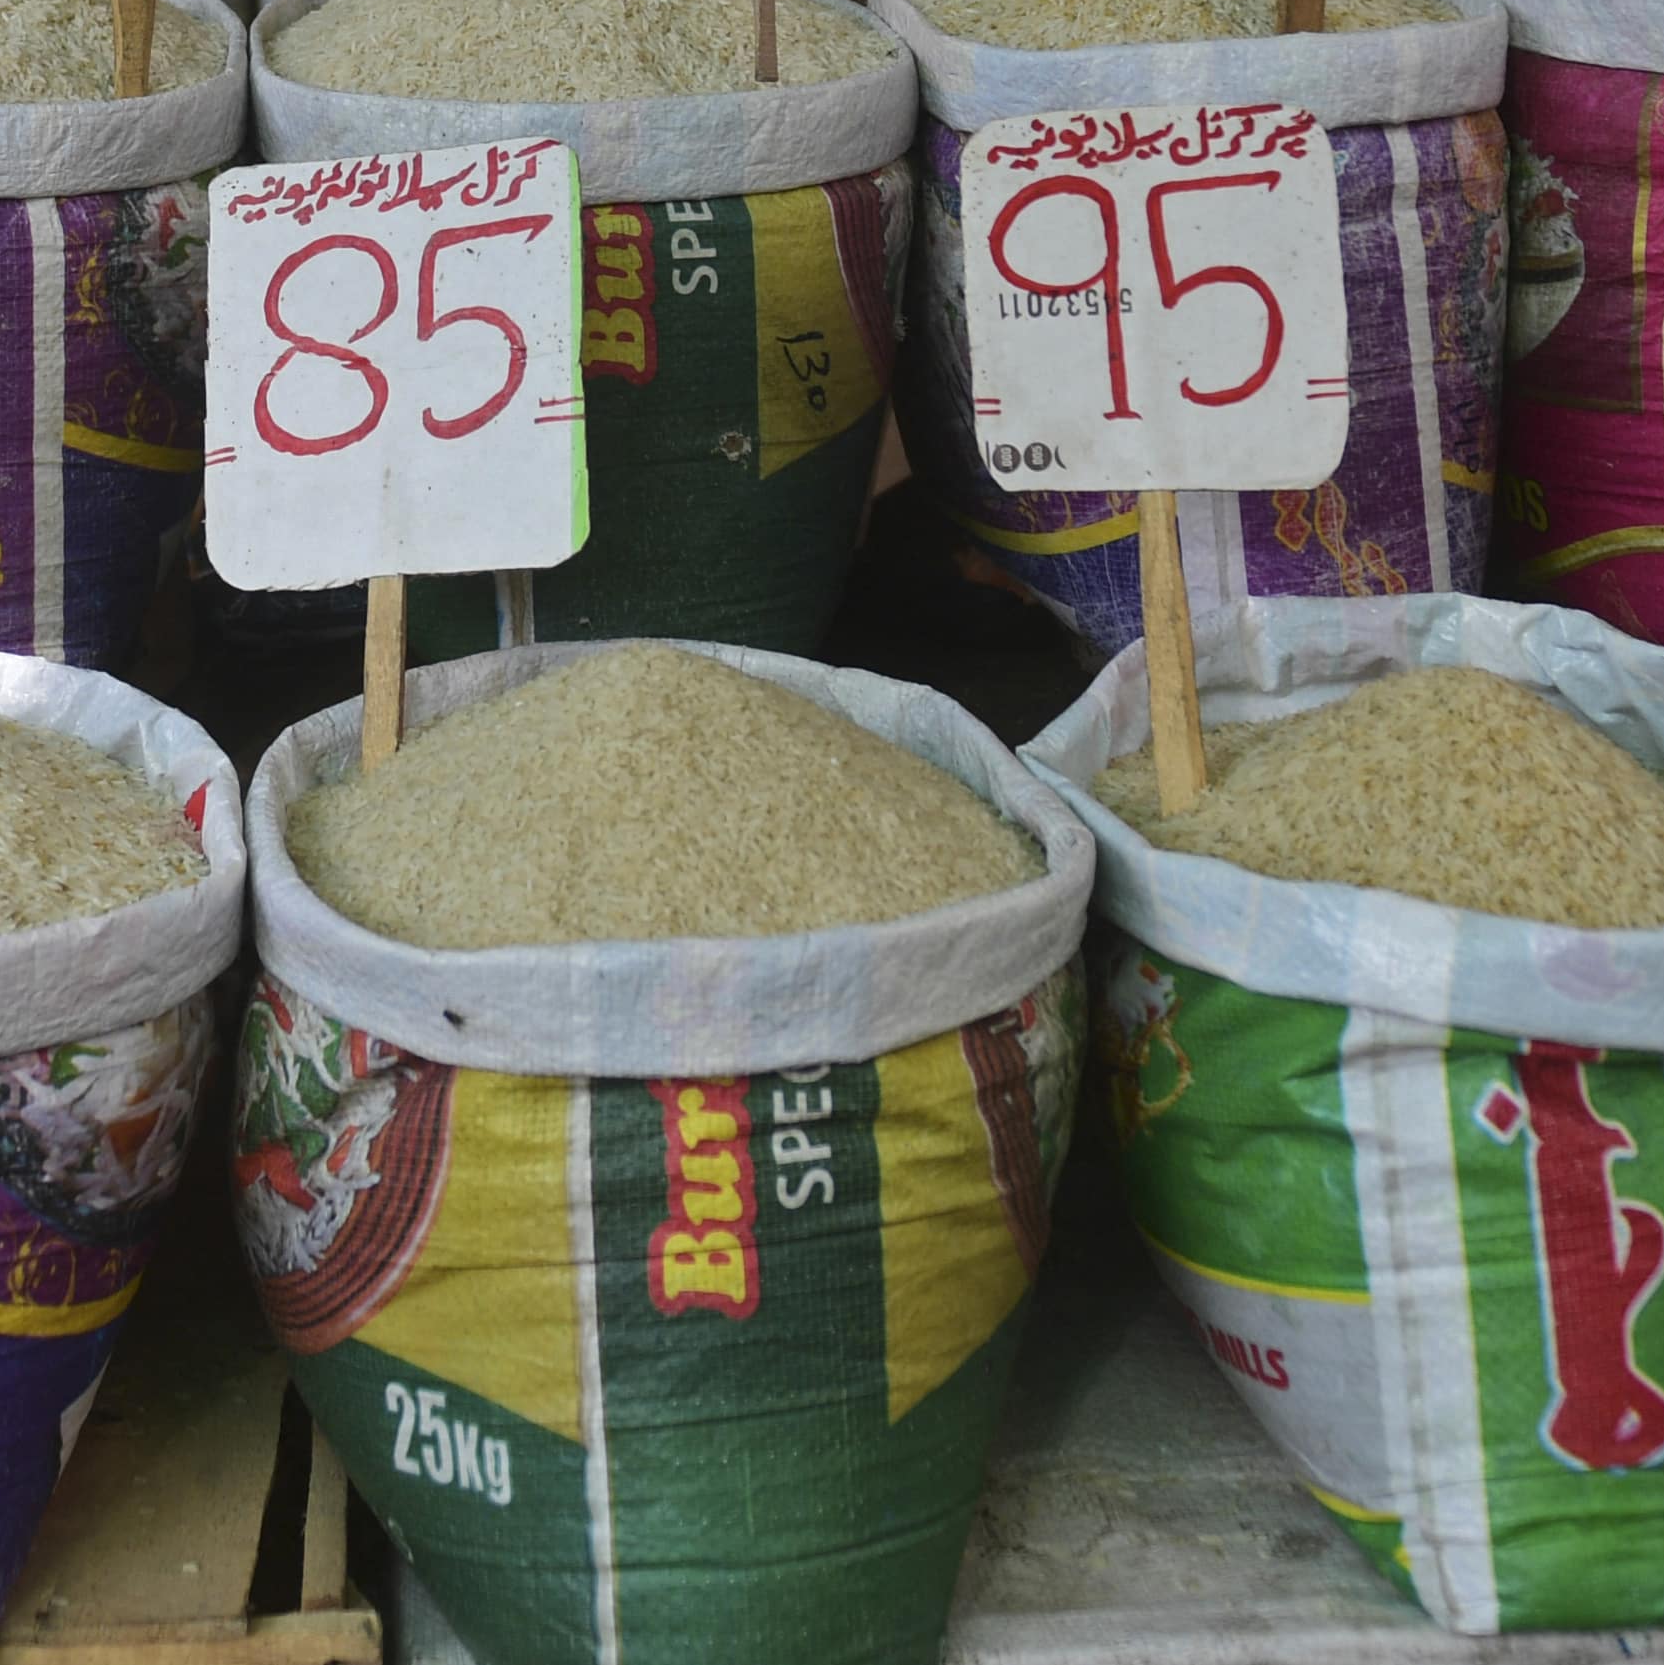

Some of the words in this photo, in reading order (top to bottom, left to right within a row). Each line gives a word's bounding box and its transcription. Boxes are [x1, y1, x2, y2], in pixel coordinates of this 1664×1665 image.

[253, 213, 553, 456] 85
[988, 170, 1285, 421] 95
[653, 1077, 757, 1314] Bur
